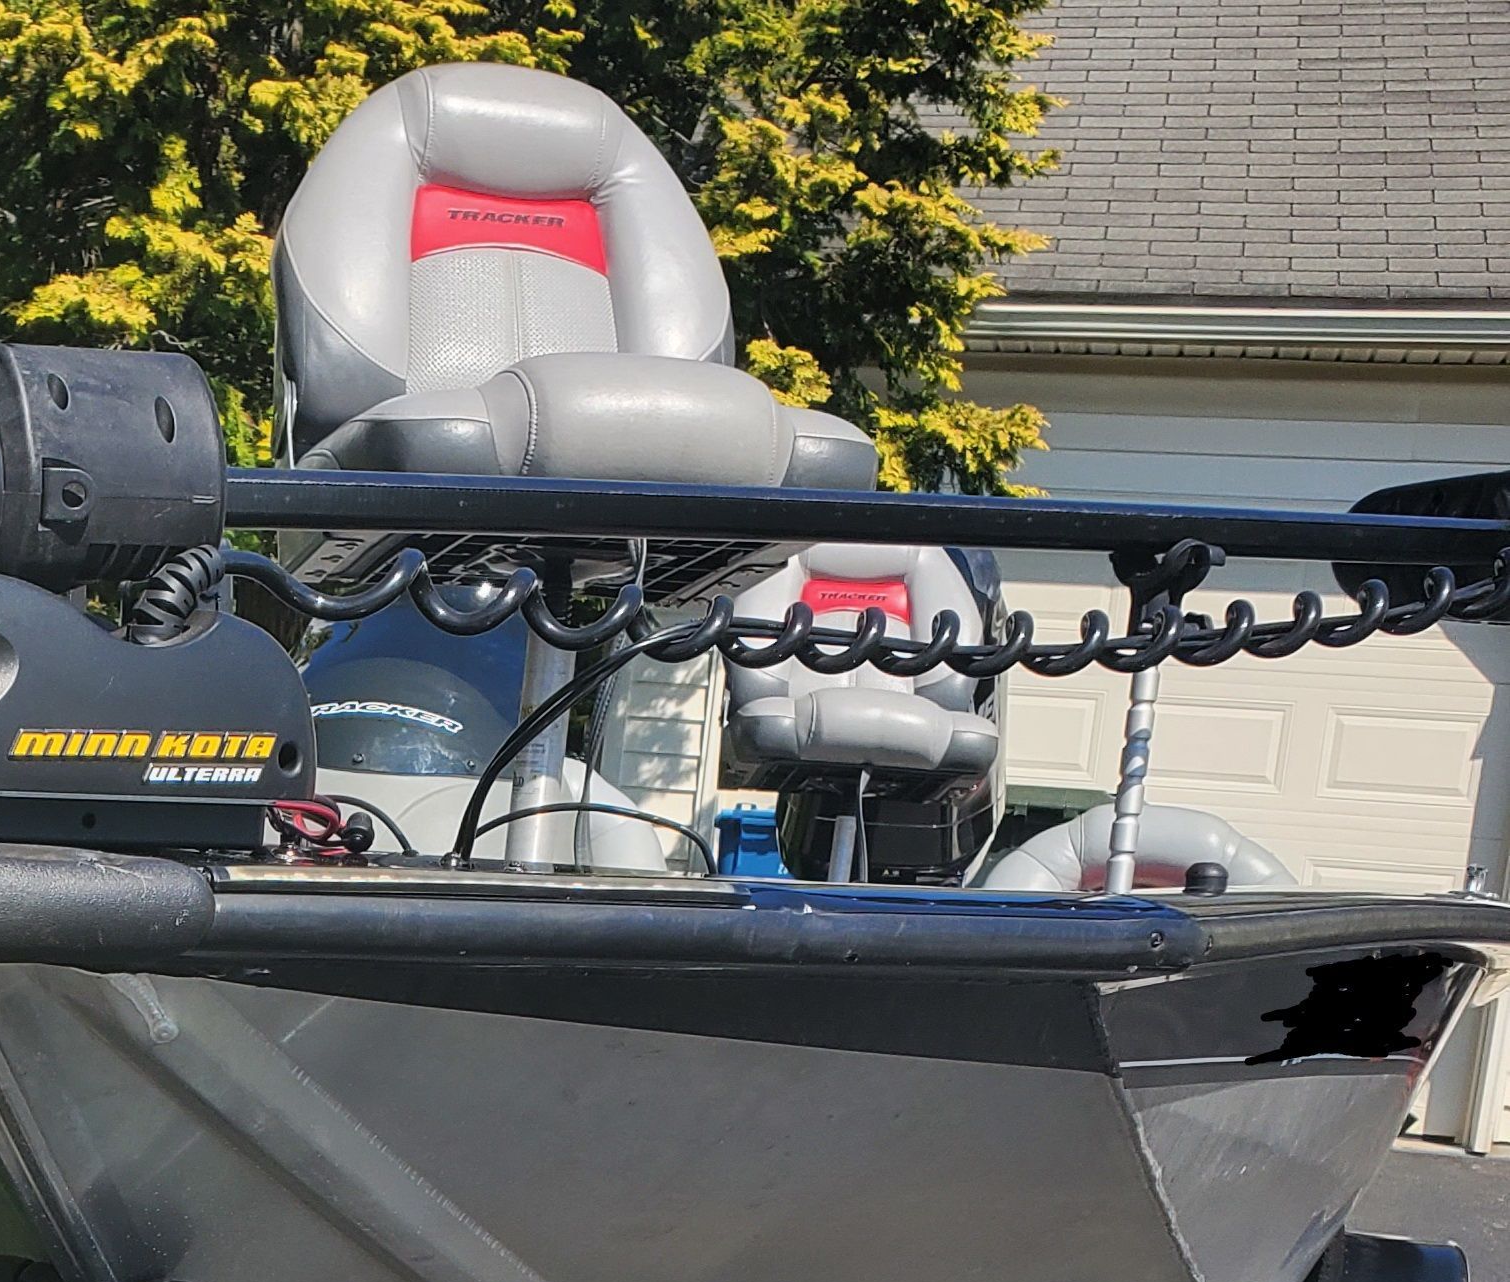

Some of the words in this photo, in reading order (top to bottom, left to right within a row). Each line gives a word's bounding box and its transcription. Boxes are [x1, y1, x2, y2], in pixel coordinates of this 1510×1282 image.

[447, 209, 566, 228] TRACKER
[819, 592, 888, 602] TRACKER
[310, 700, 464, 734] RACKER
[9, 728, 152, 758] MINN
[151, 731, 278, 760] KOTA
[146, 765, 264, 783] ULTERRA
